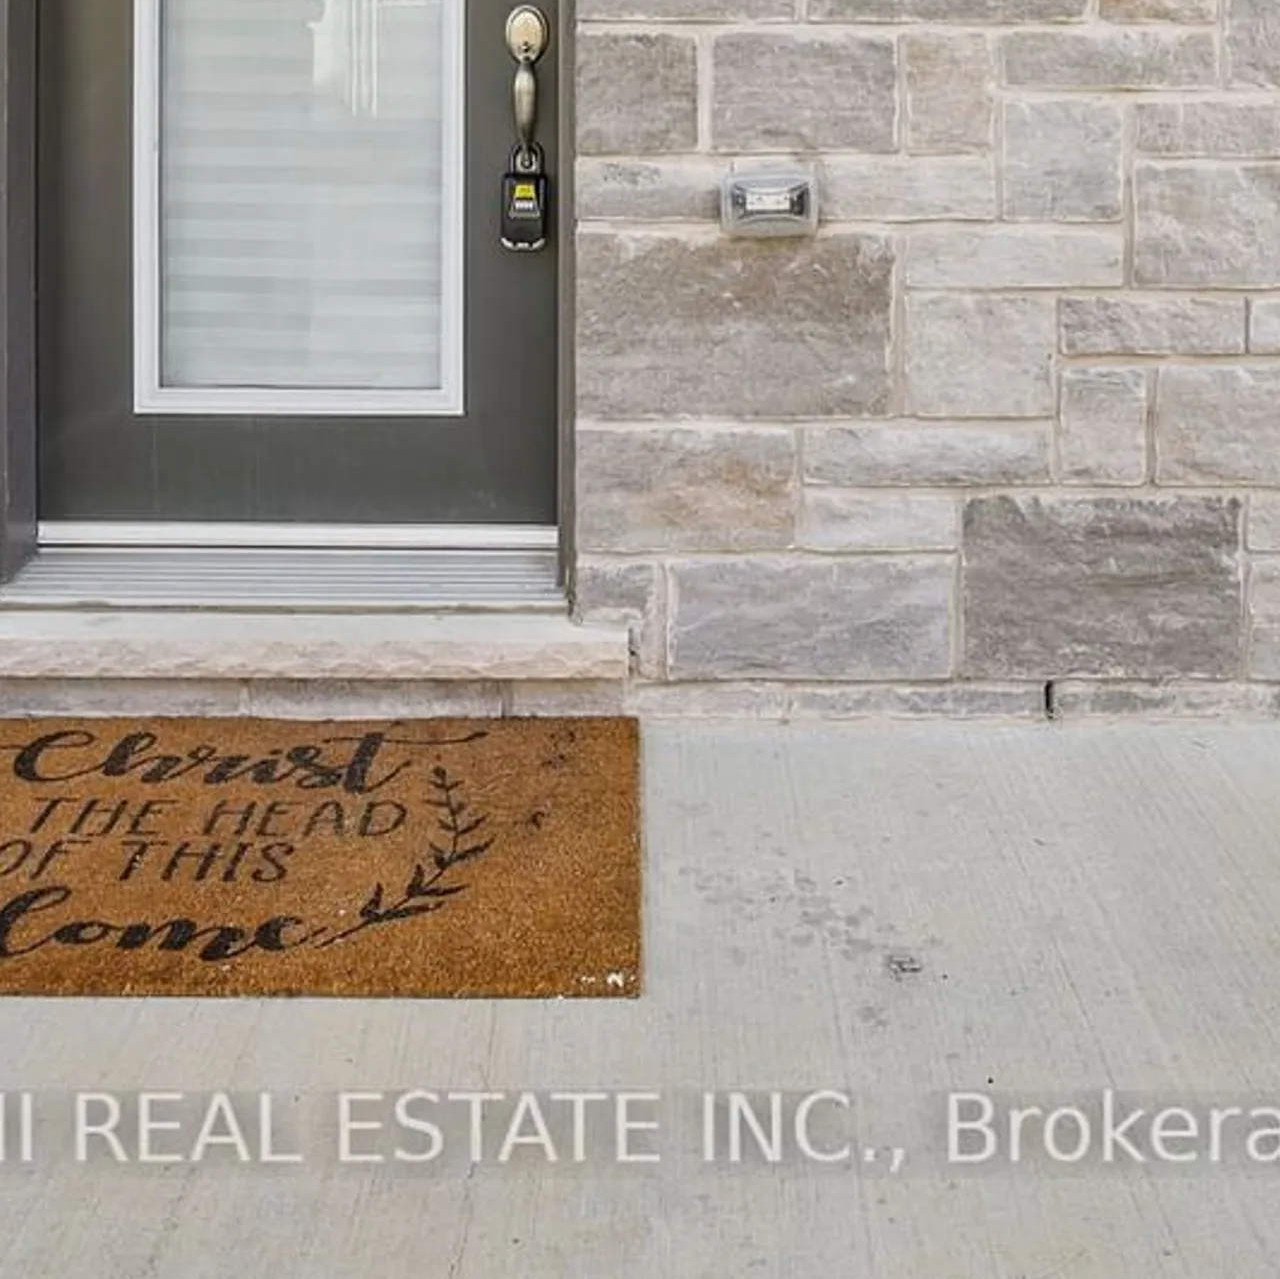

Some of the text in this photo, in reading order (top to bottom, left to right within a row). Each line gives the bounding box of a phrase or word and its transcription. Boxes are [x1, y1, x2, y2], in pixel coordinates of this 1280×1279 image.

[31, 797, 178, 837] THE
[190, 797, 409, 838] HEAD
[118, 838, 297, 883] THIS
